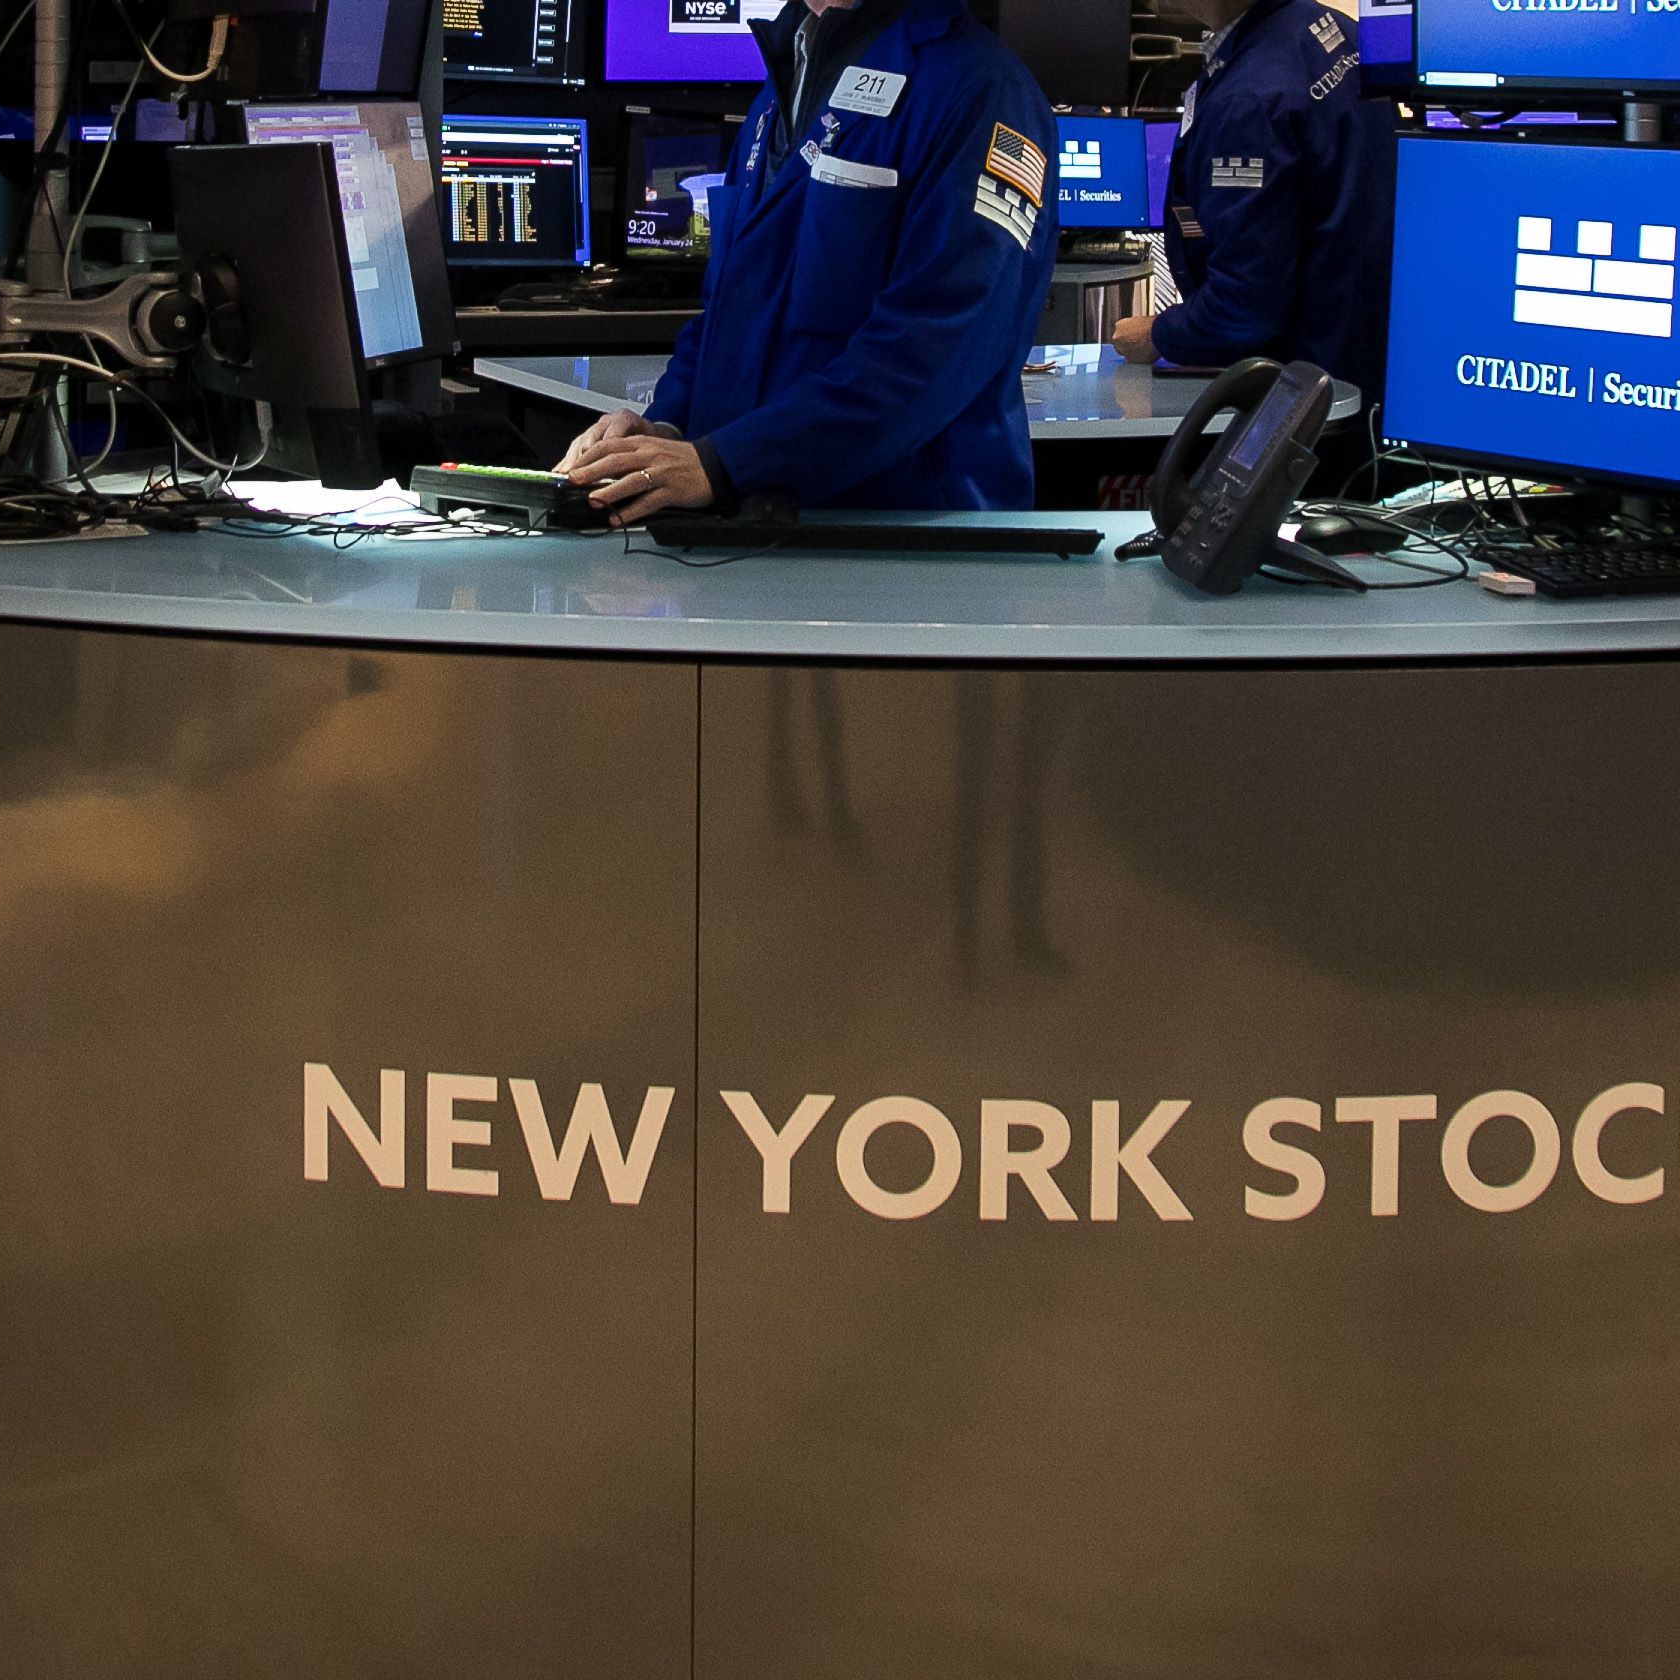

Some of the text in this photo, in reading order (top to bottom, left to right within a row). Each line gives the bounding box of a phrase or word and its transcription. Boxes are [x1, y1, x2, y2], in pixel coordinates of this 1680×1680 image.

[854, 74, 887, 95] 211
[1080, 188, 1122, 204] Securities
[628, 219, 656, 236] 9:20
[628, 235, 693, 248] Wednesday, January 24
[1456, 354, 1577, 399] CITADEL
[304, 1063, 677, 1207] NEW
[723, 1090, 1193, 1222] YORK
